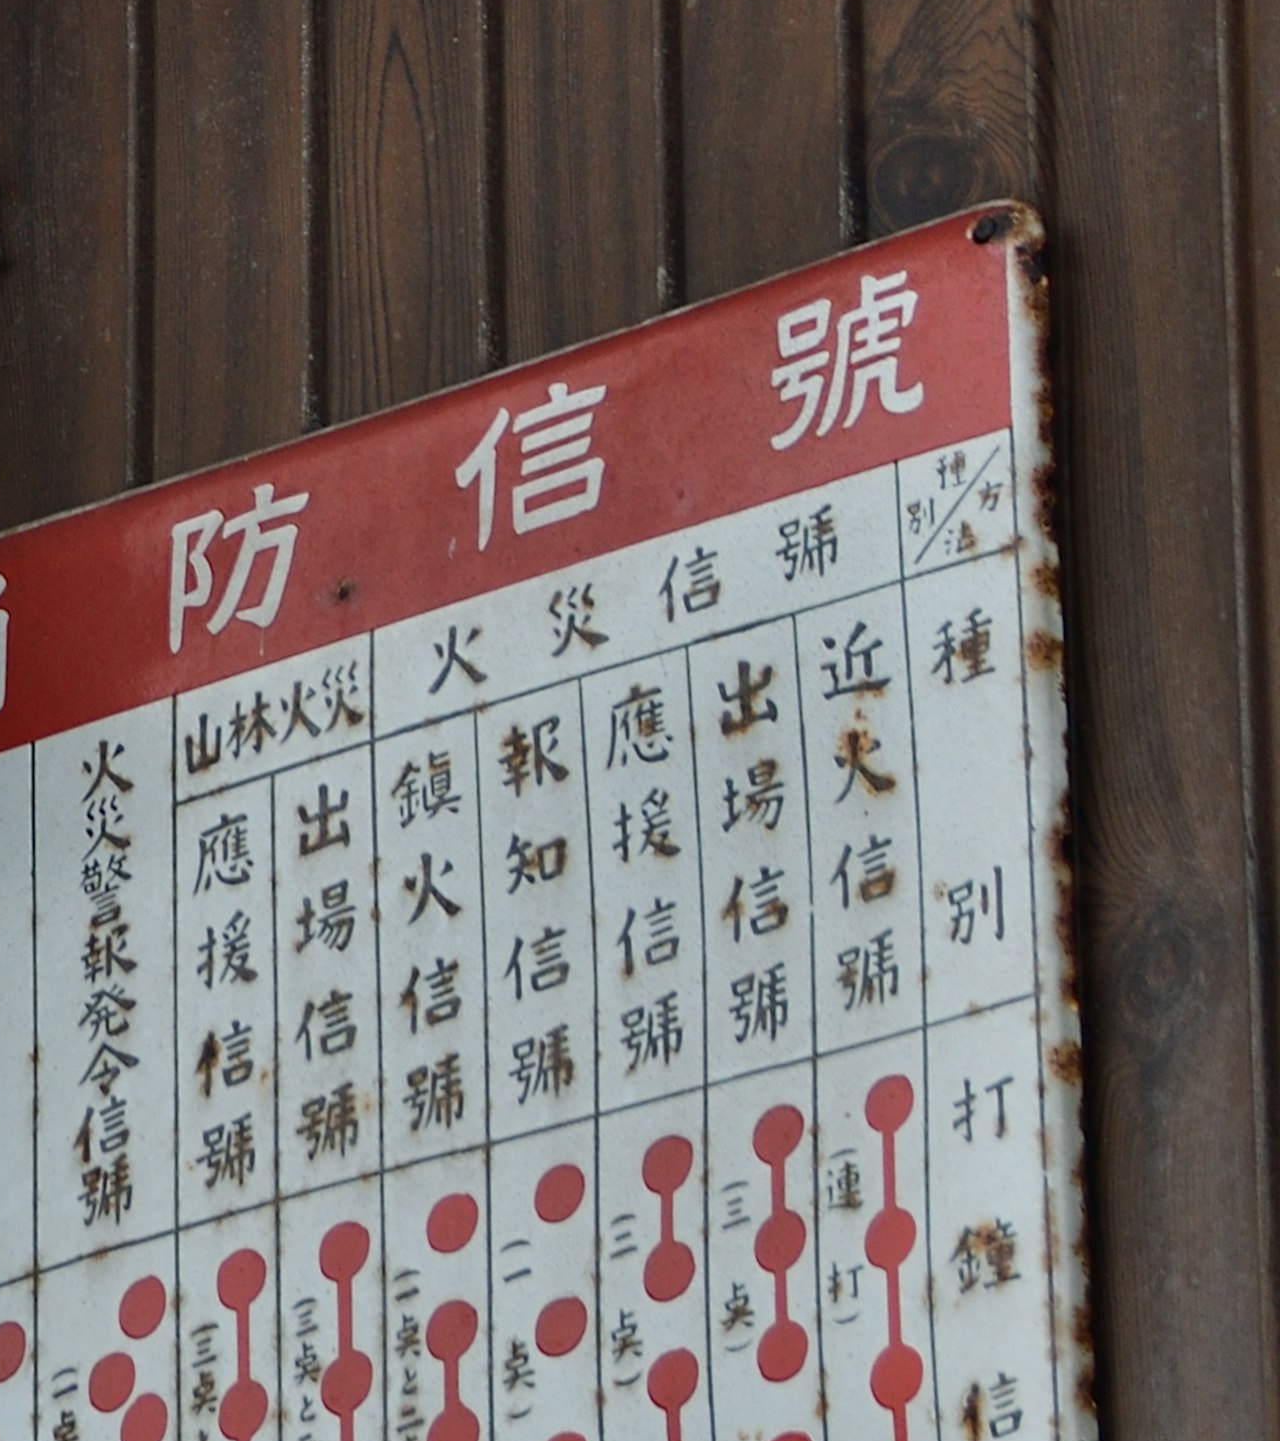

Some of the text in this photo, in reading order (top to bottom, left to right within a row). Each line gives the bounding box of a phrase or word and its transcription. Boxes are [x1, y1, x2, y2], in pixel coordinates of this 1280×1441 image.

[184, 659, 366, 777] 山林火災
[428, 503, 839, 696] 火災信號
[930, 607, 1005, 946] 種別
[72, 739, 140, 1228] 火災警報発令信號
[192, 813, 263, 1191] 應援信號
[293, 783, 360, 1163] 出場信號
[497, 715, 576, 1106] 報知信號
[605, 683, 683, 1076] 應援信號
[716, 659, 790, 1044] 出場信號
[820, 620, 899, 1012] 近火信號
